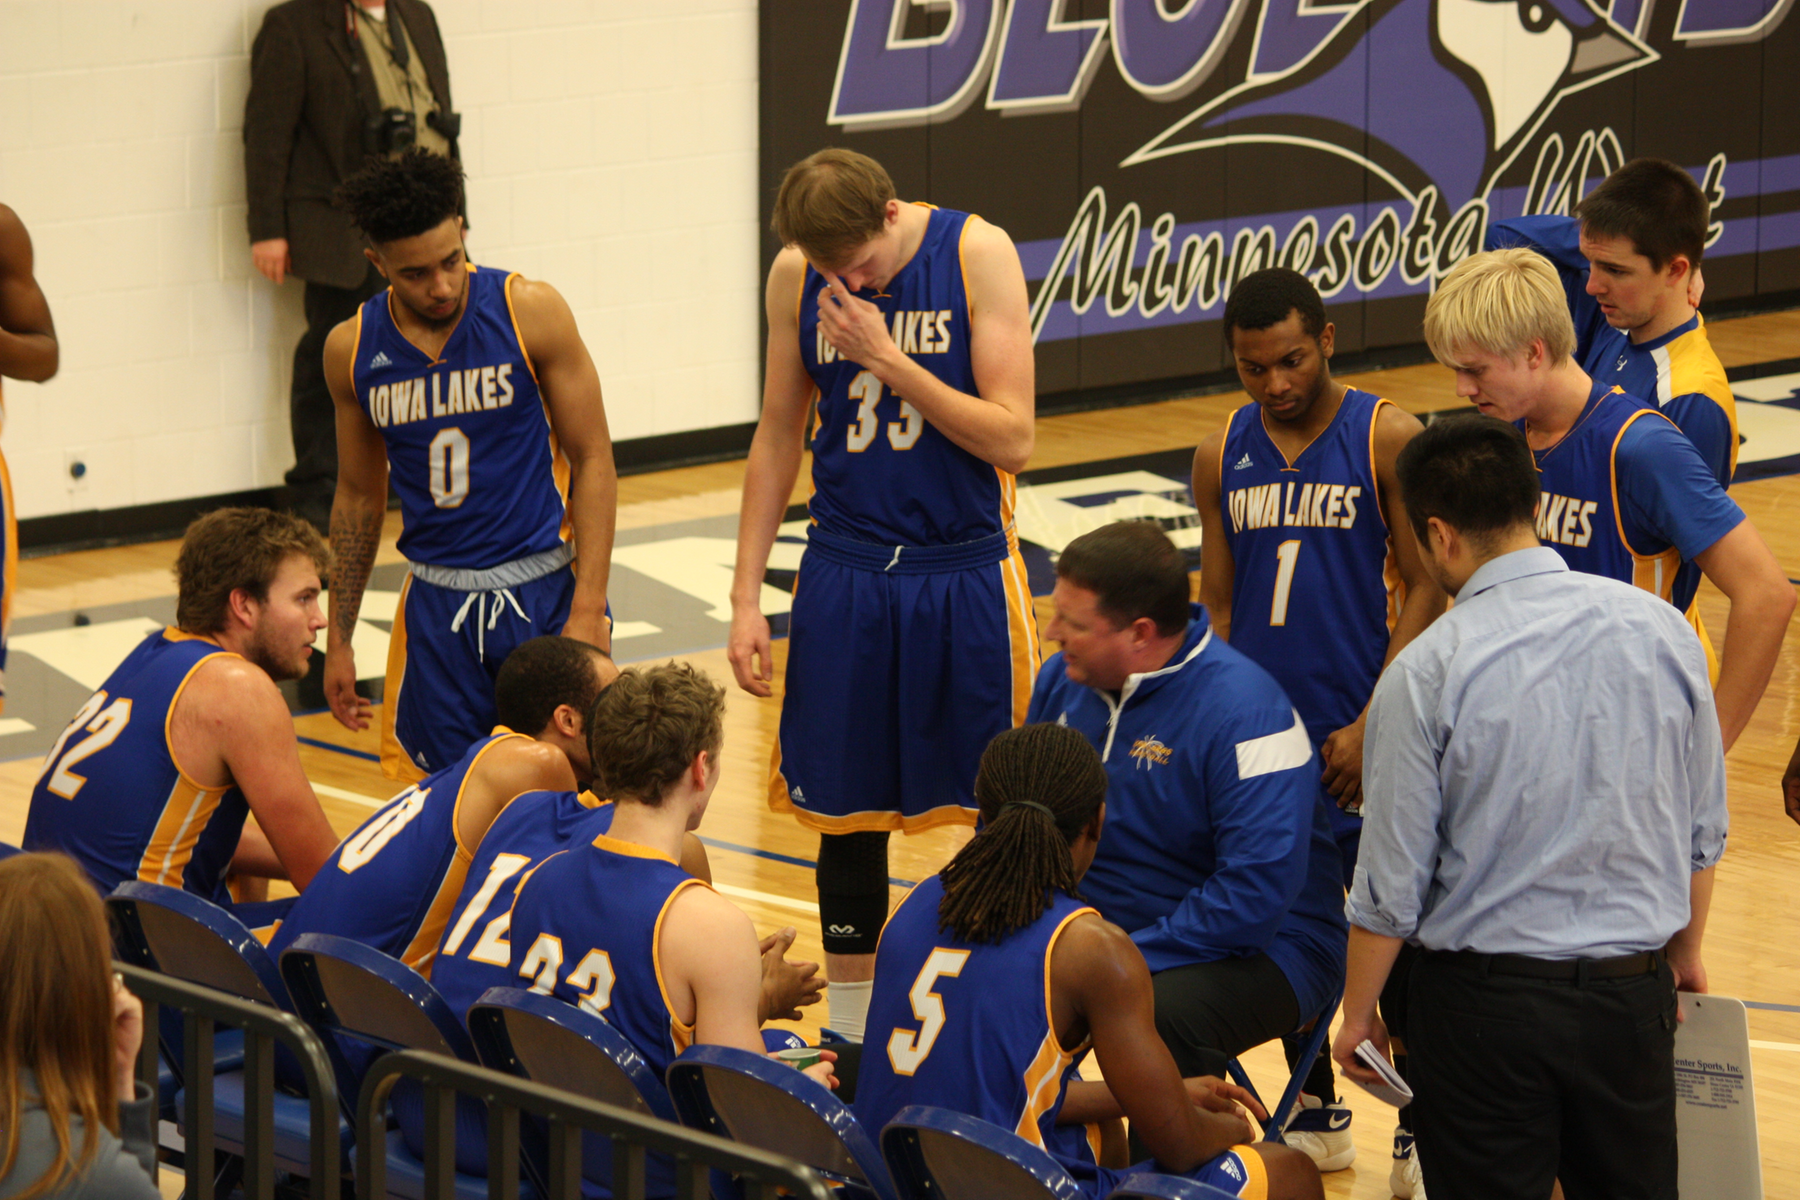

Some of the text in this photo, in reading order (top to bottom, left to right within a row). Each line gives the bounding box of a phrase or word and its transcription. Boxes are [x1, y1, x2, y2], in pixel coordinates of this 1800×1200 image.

[1521, 127, 1726, 250] Wt
[880, 310, 952, 354] AKES
[369, 363, 514, 428] IOWA LAKES
[429, 426, 470, 508] 0
[1228, 482, 1282, 534] IOWA
[1283, 481, 1361, 529] LAKES
[1535, 491, 1598, 548] AKES
[1270, 539, 1301, 626] 1
[887, 946, 971, 1076] 5
[1674, 1058, 1742, 1073] enter Sports, Inc.
